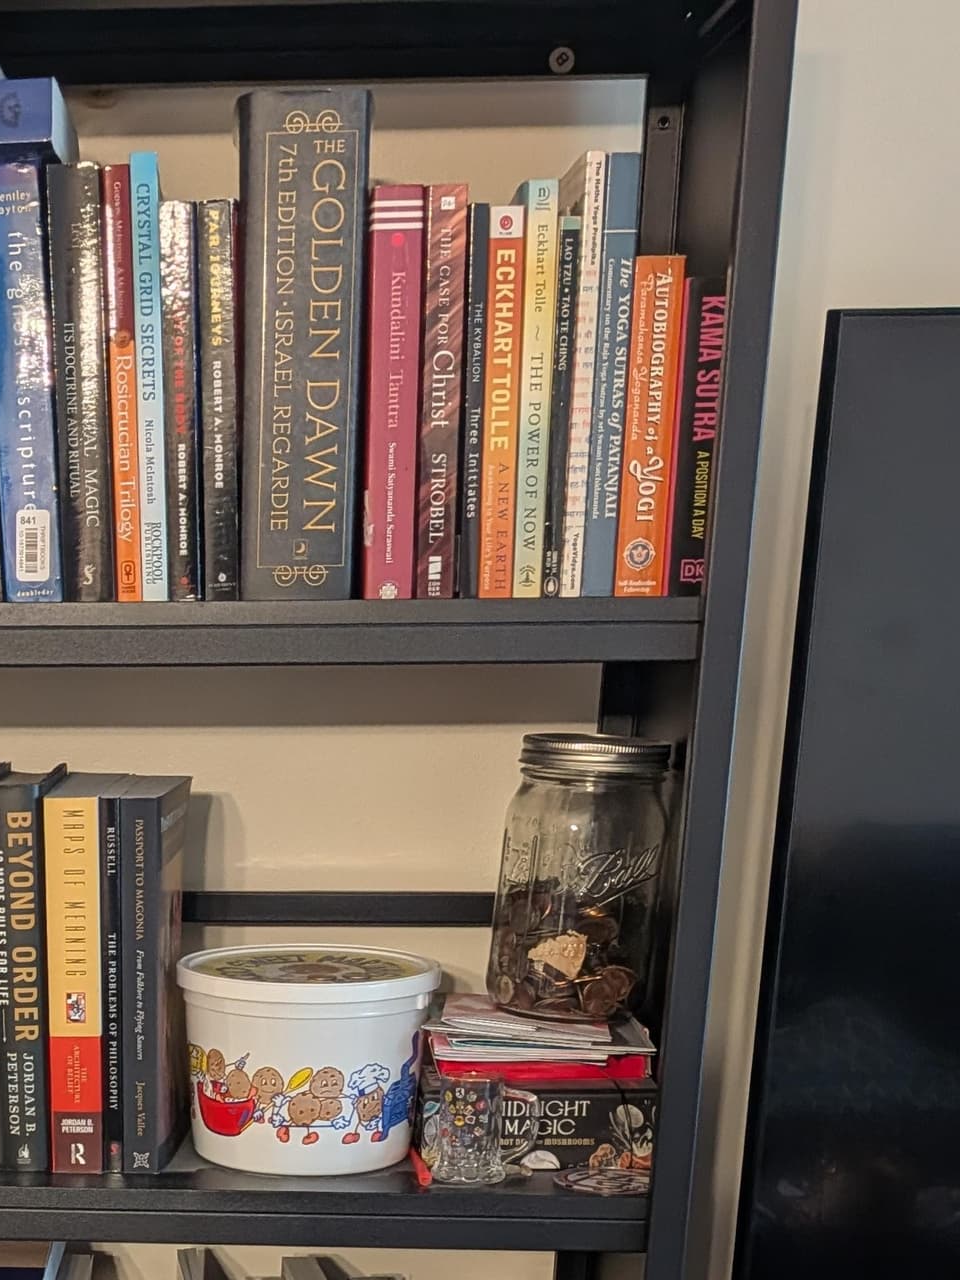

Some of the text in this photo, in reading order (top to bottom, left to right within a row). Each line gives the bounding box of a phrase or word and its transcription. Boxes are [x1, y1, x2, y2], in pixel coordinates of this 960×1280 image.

[313, 139, 345, 154] THE
[136, 183, 155, 401] CRYSTAL GRID SECRETS
[301, 159, 345, 533] GOLDEN DAWN
[490, 249, 515, 451] ECKHART TOLLE
[429, 350, 456, 427] Christ
[691, 296, 725, 442] KAMA SUTRA
[428, 453, 446, 543] STROBEL
[522, 354, 543, 550] THE POWER OF NOW
[61, 809, 88, 977] MAPS OF MEANING
[106, 827, 115, 876] RUSSELL
[6, 811, 38, 1042] BEYOND ORDER
[6, 1052, 21, 1136] PETERSON
[21, 1052, 35, 1136] JORDAN B.
